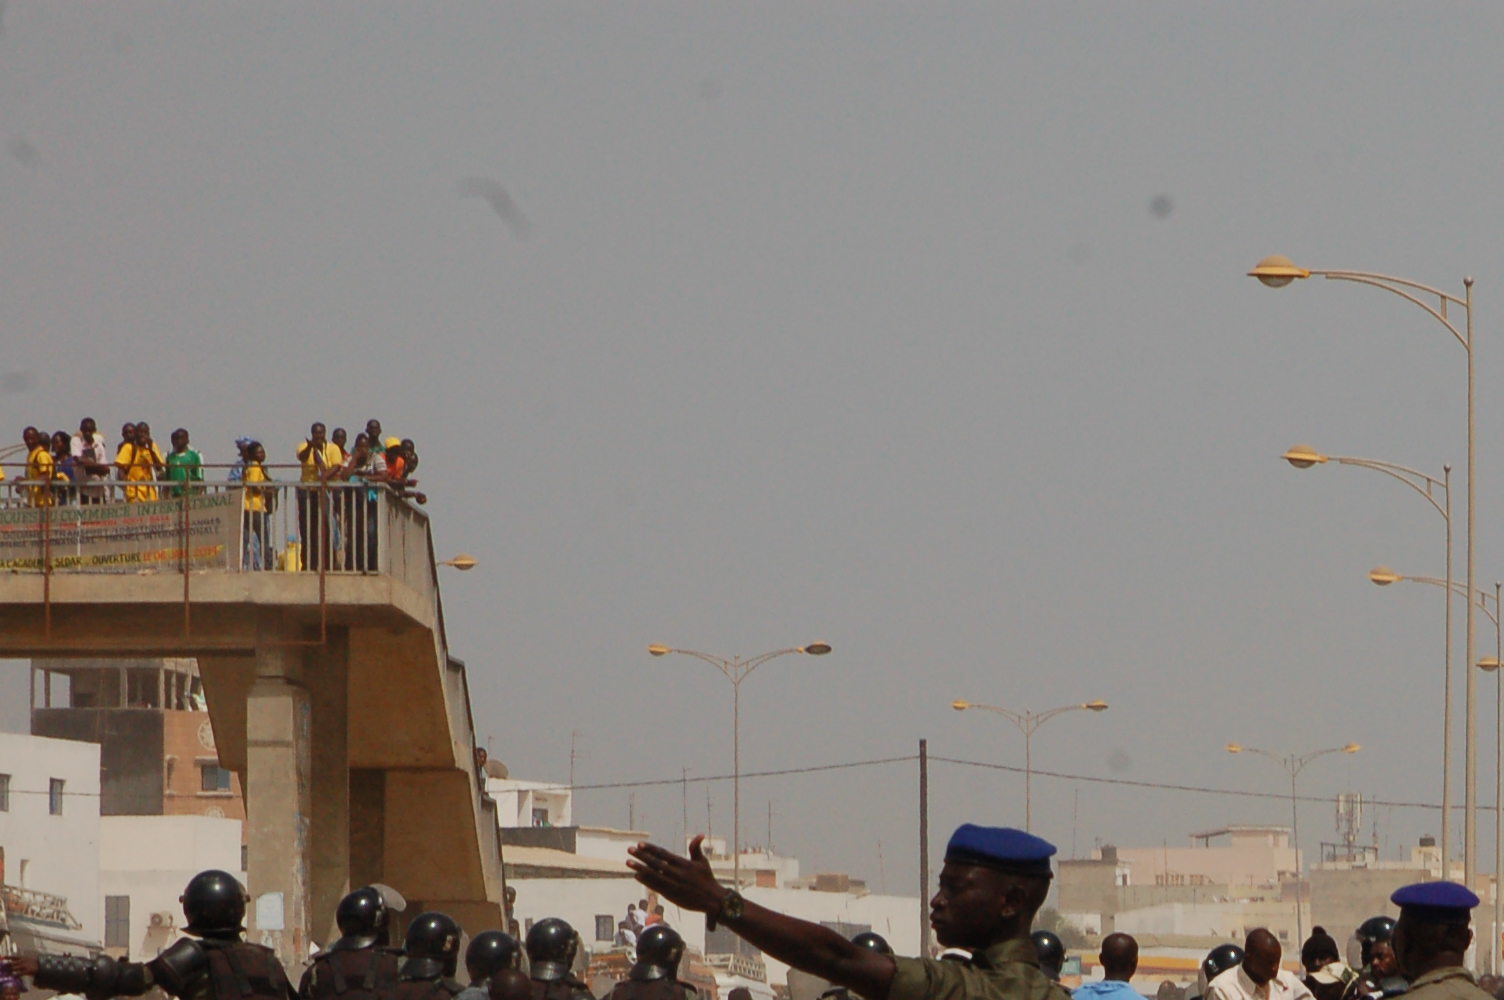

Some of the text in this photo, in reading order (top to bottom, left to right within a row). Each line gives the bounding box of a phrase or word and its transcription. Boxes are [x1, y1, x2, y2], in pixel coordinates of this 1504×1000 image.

[61, 506, 130, 521] COMMERCE
[138, 494, 232, 515] INTERNTIONAL
[92, 551, 141, 566] OUVERTURE
